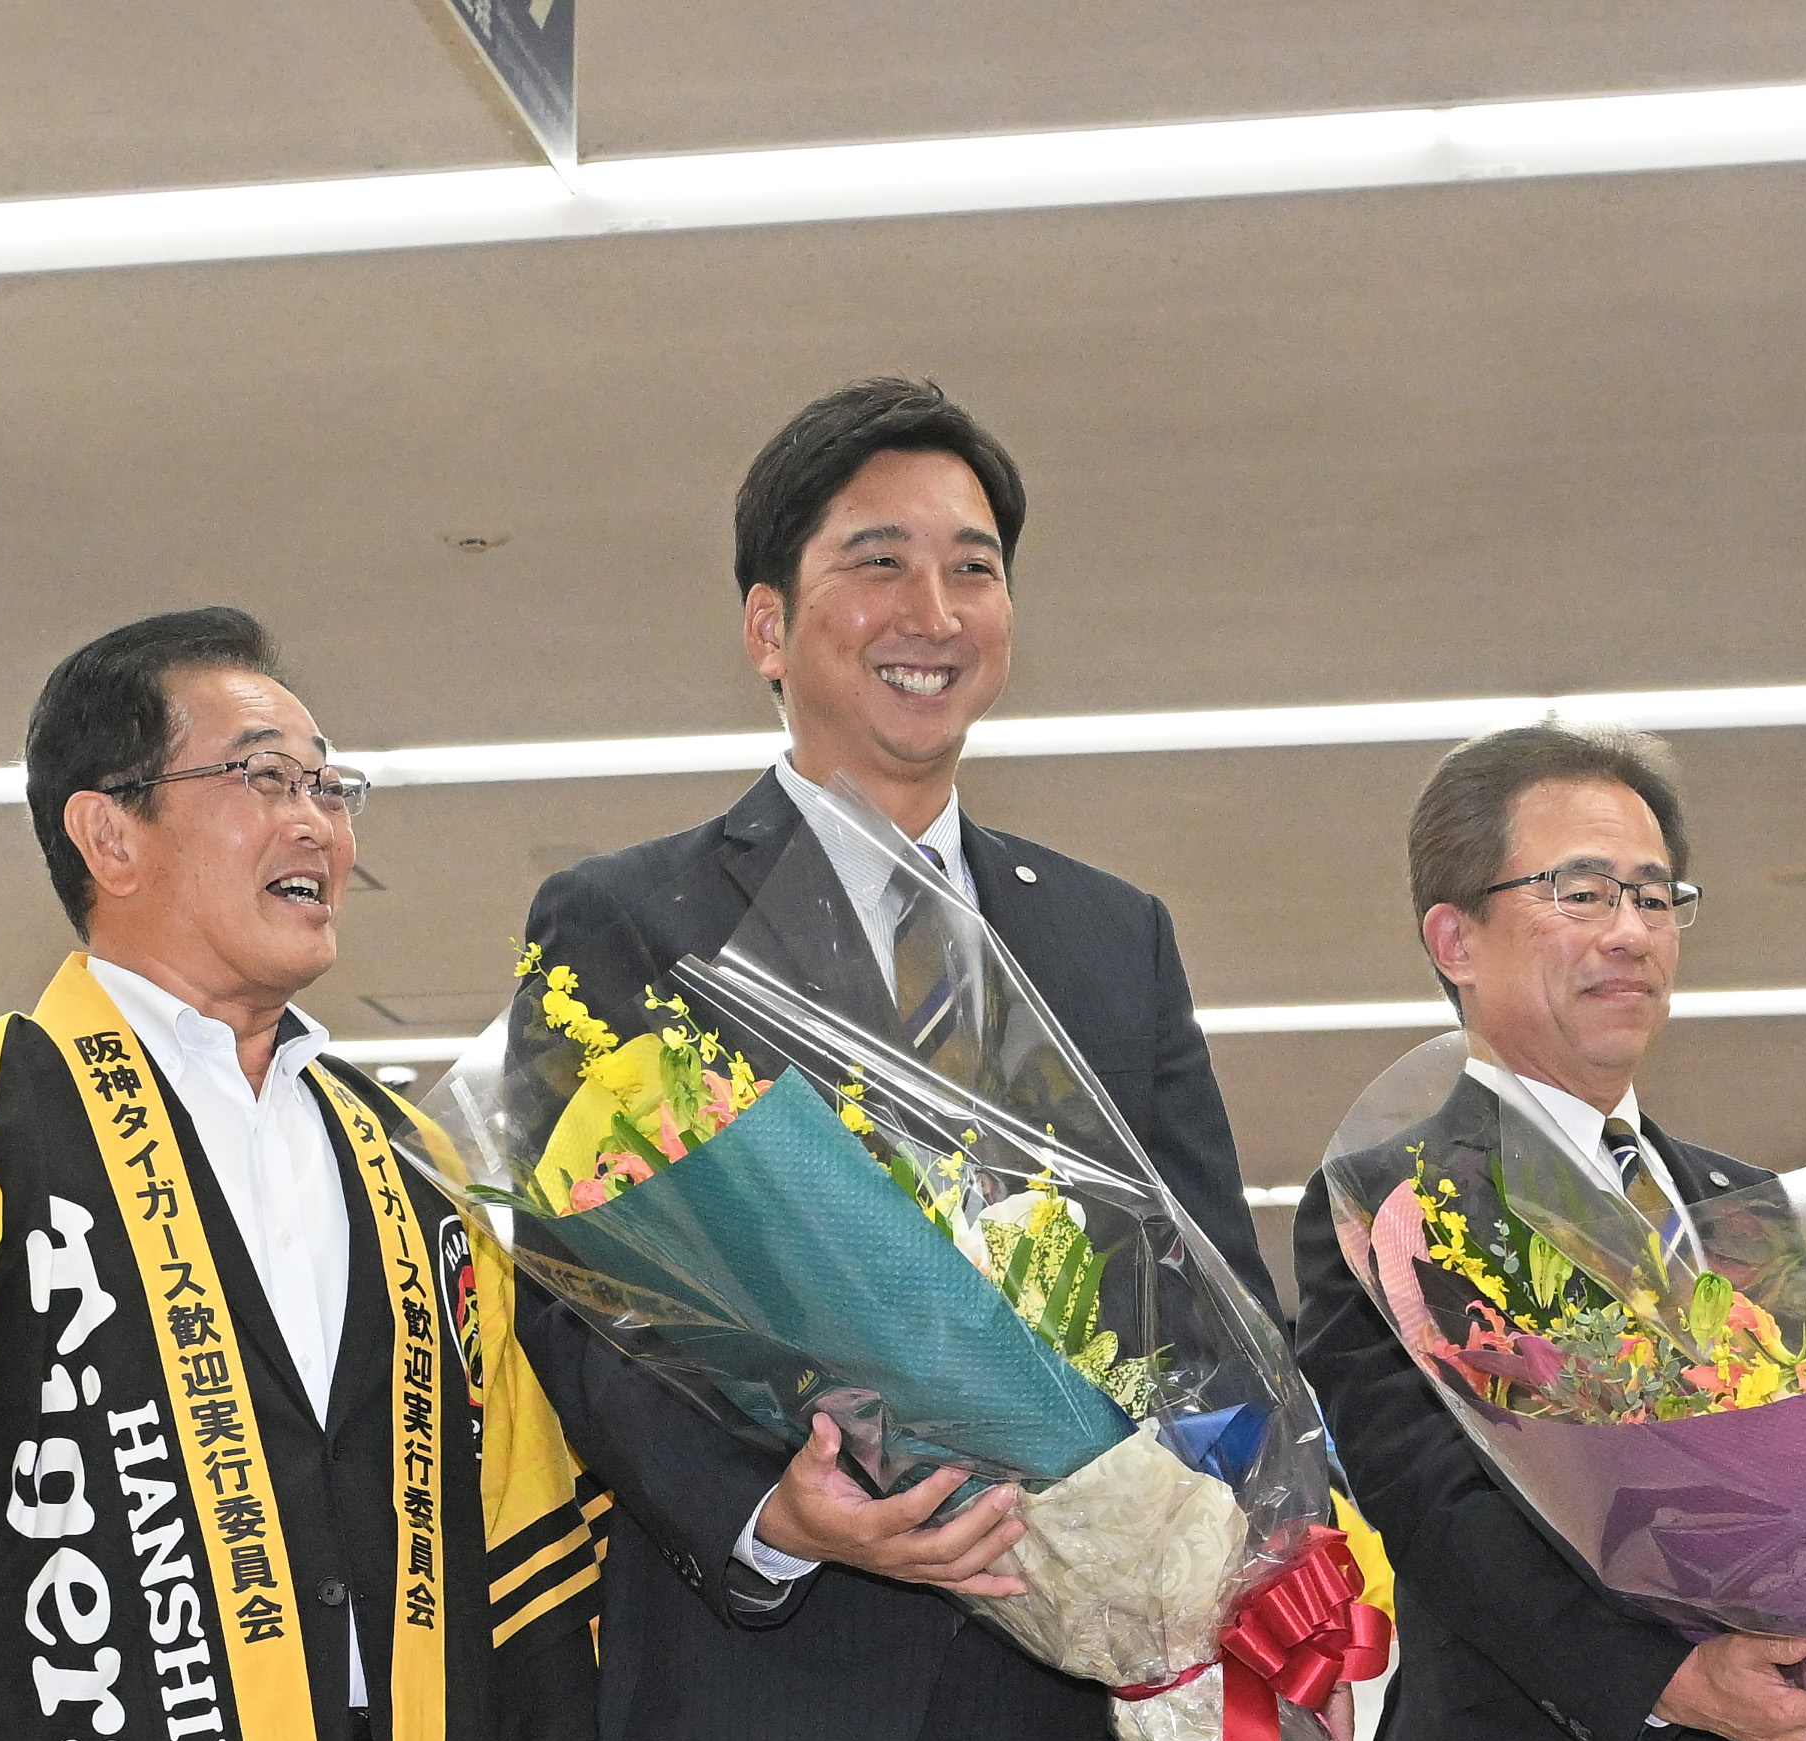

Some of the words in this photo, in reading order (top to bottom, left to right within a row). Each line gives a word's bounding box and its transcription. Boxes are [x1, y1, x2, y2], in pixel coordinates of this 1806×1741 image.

[73, 1029, 285, 1645] 阪神タイガース歓迎実行委員会
